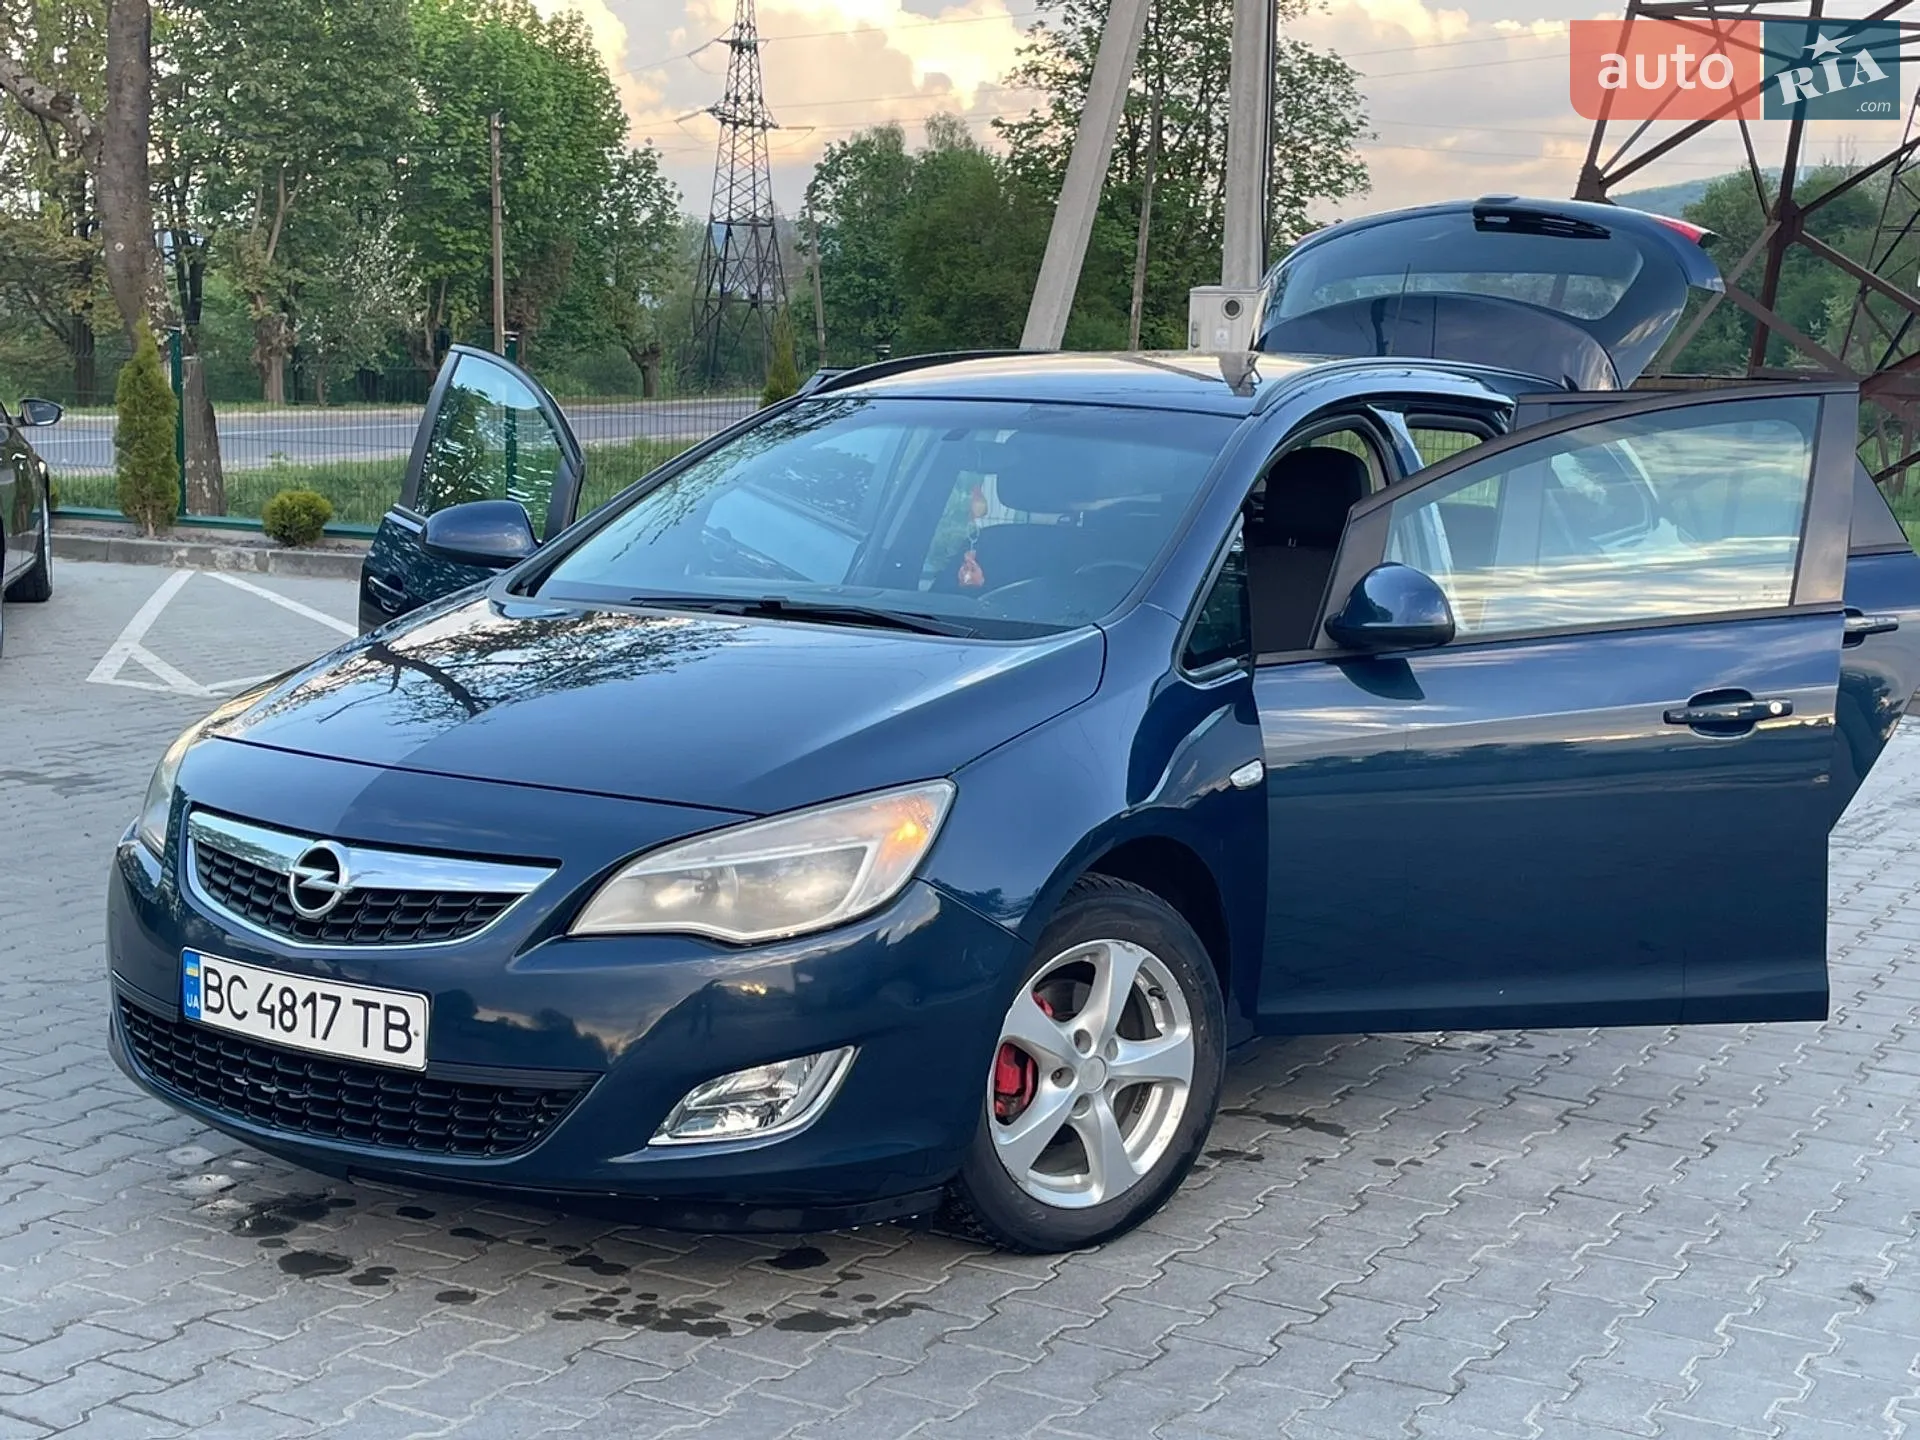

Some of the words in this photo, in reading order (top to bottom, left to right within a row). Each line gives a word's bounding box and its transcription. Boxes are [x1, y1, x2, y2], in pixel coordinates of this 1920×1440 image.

[186, 993, 200, 1010] UA
[203, 966, 248, 1021] BC
[257, 983, 342, 1041] 4817
[352, 998, 413, 1054] TB
